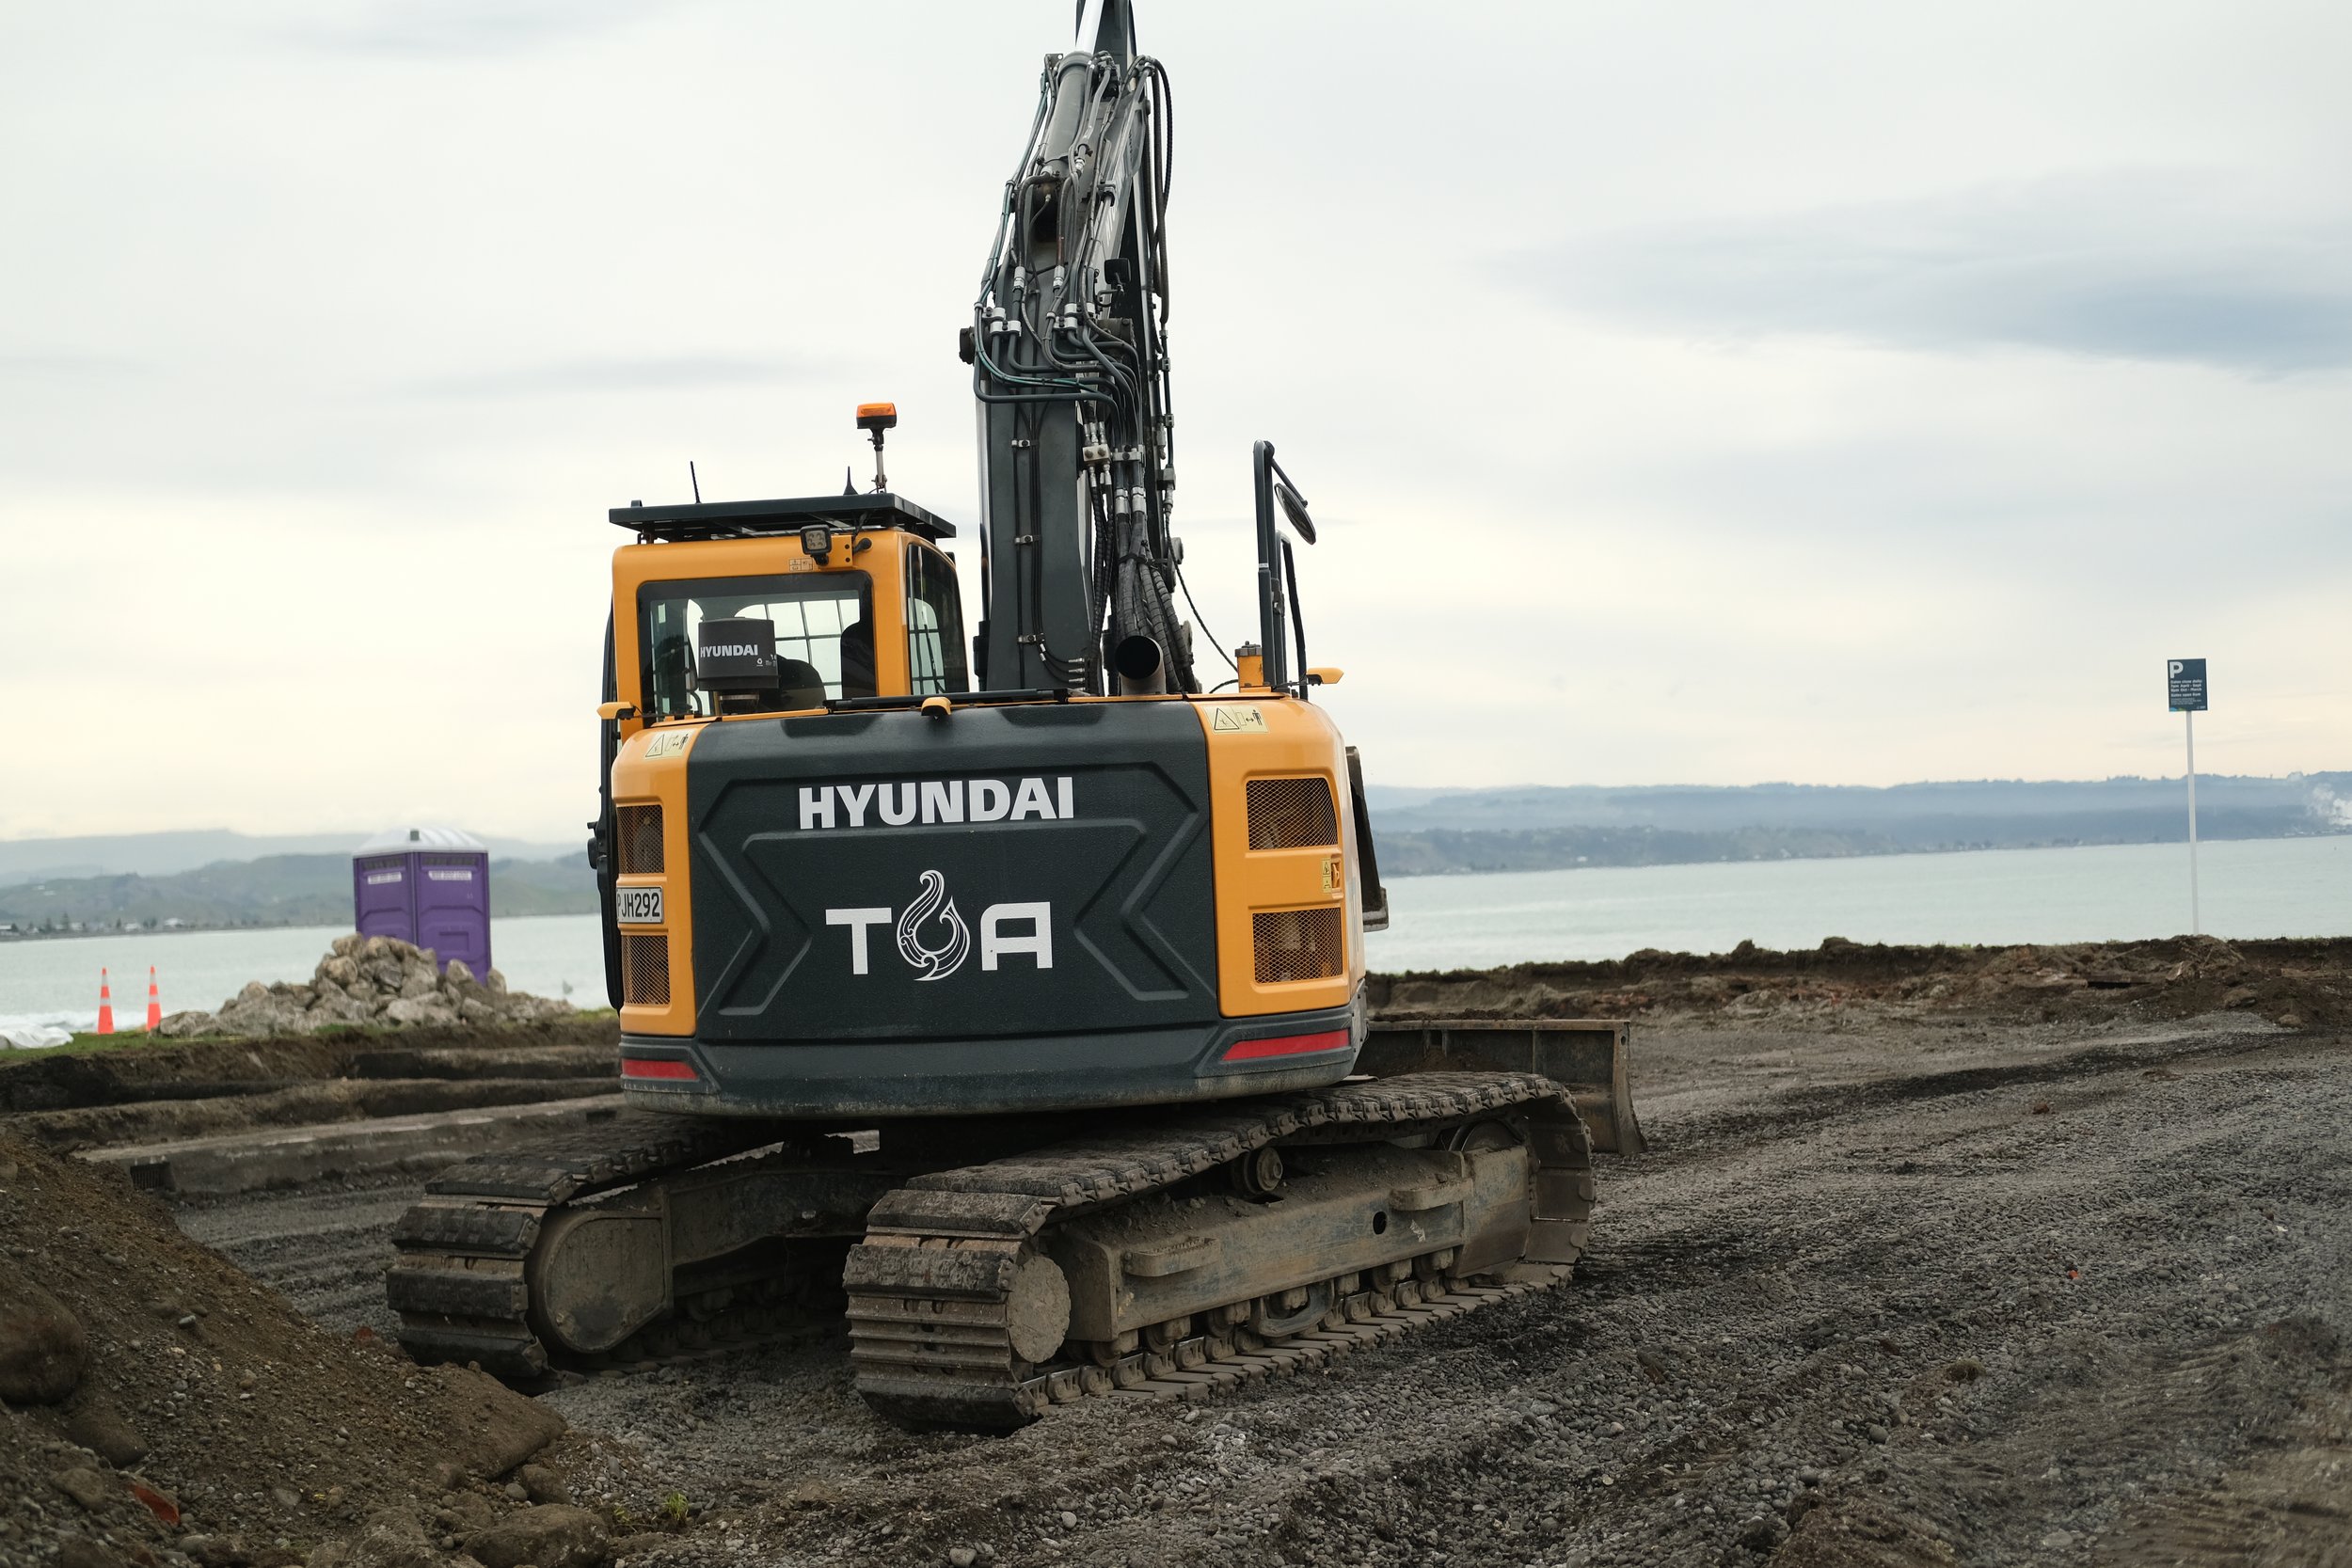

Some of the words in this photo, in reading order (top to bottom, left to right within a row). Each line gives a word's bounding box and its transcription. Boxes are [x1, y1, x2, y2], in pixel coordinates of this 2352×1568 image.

[700, 644, 758, 658] HYUNDAI
[2169, 661, 2184, 678] P
[799, 777, 1074, 830] HYUNDAI
[617, 892, 660, 918] PJH292
